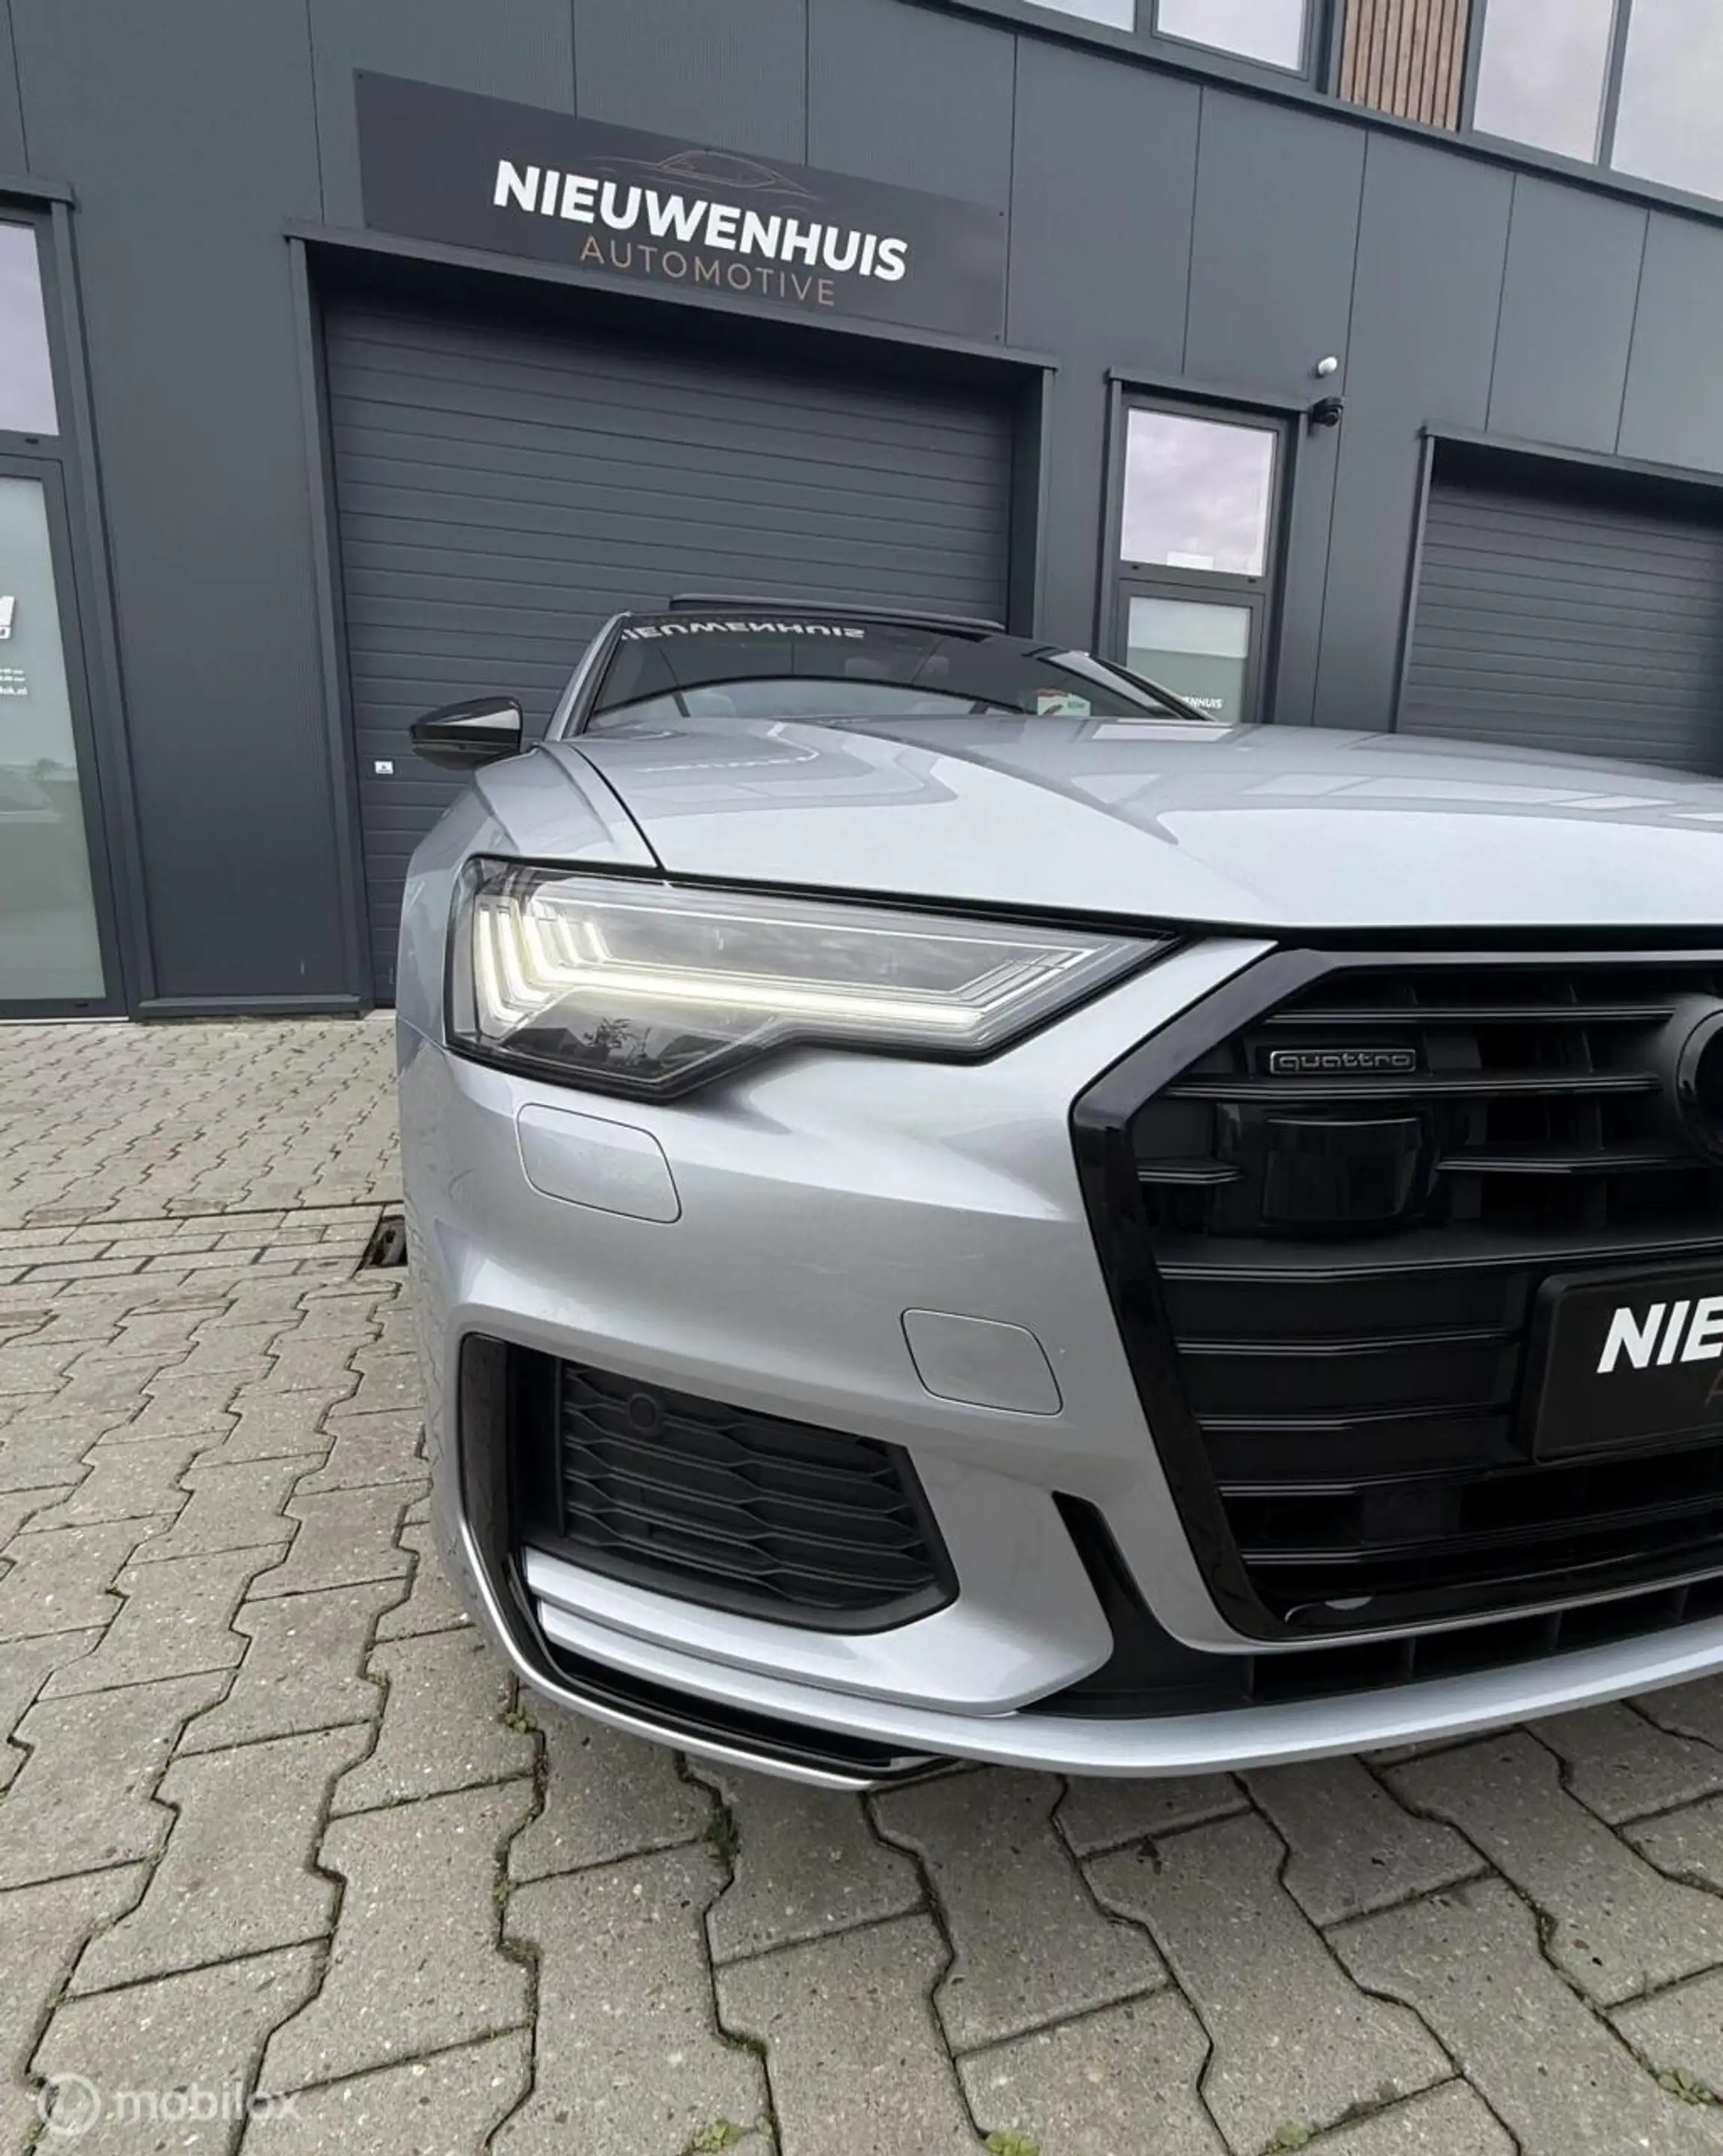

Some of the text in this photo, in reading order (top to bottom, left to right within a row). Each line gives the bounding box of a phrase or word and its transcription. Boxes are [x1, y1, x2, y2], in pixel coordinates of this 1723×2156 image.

[493, 159, 908, 282] NIEUWENHUIS
[580, 235, 835, 307] AUTOMOTIVE
[1279, 1053, 1410, 1071] quattro
